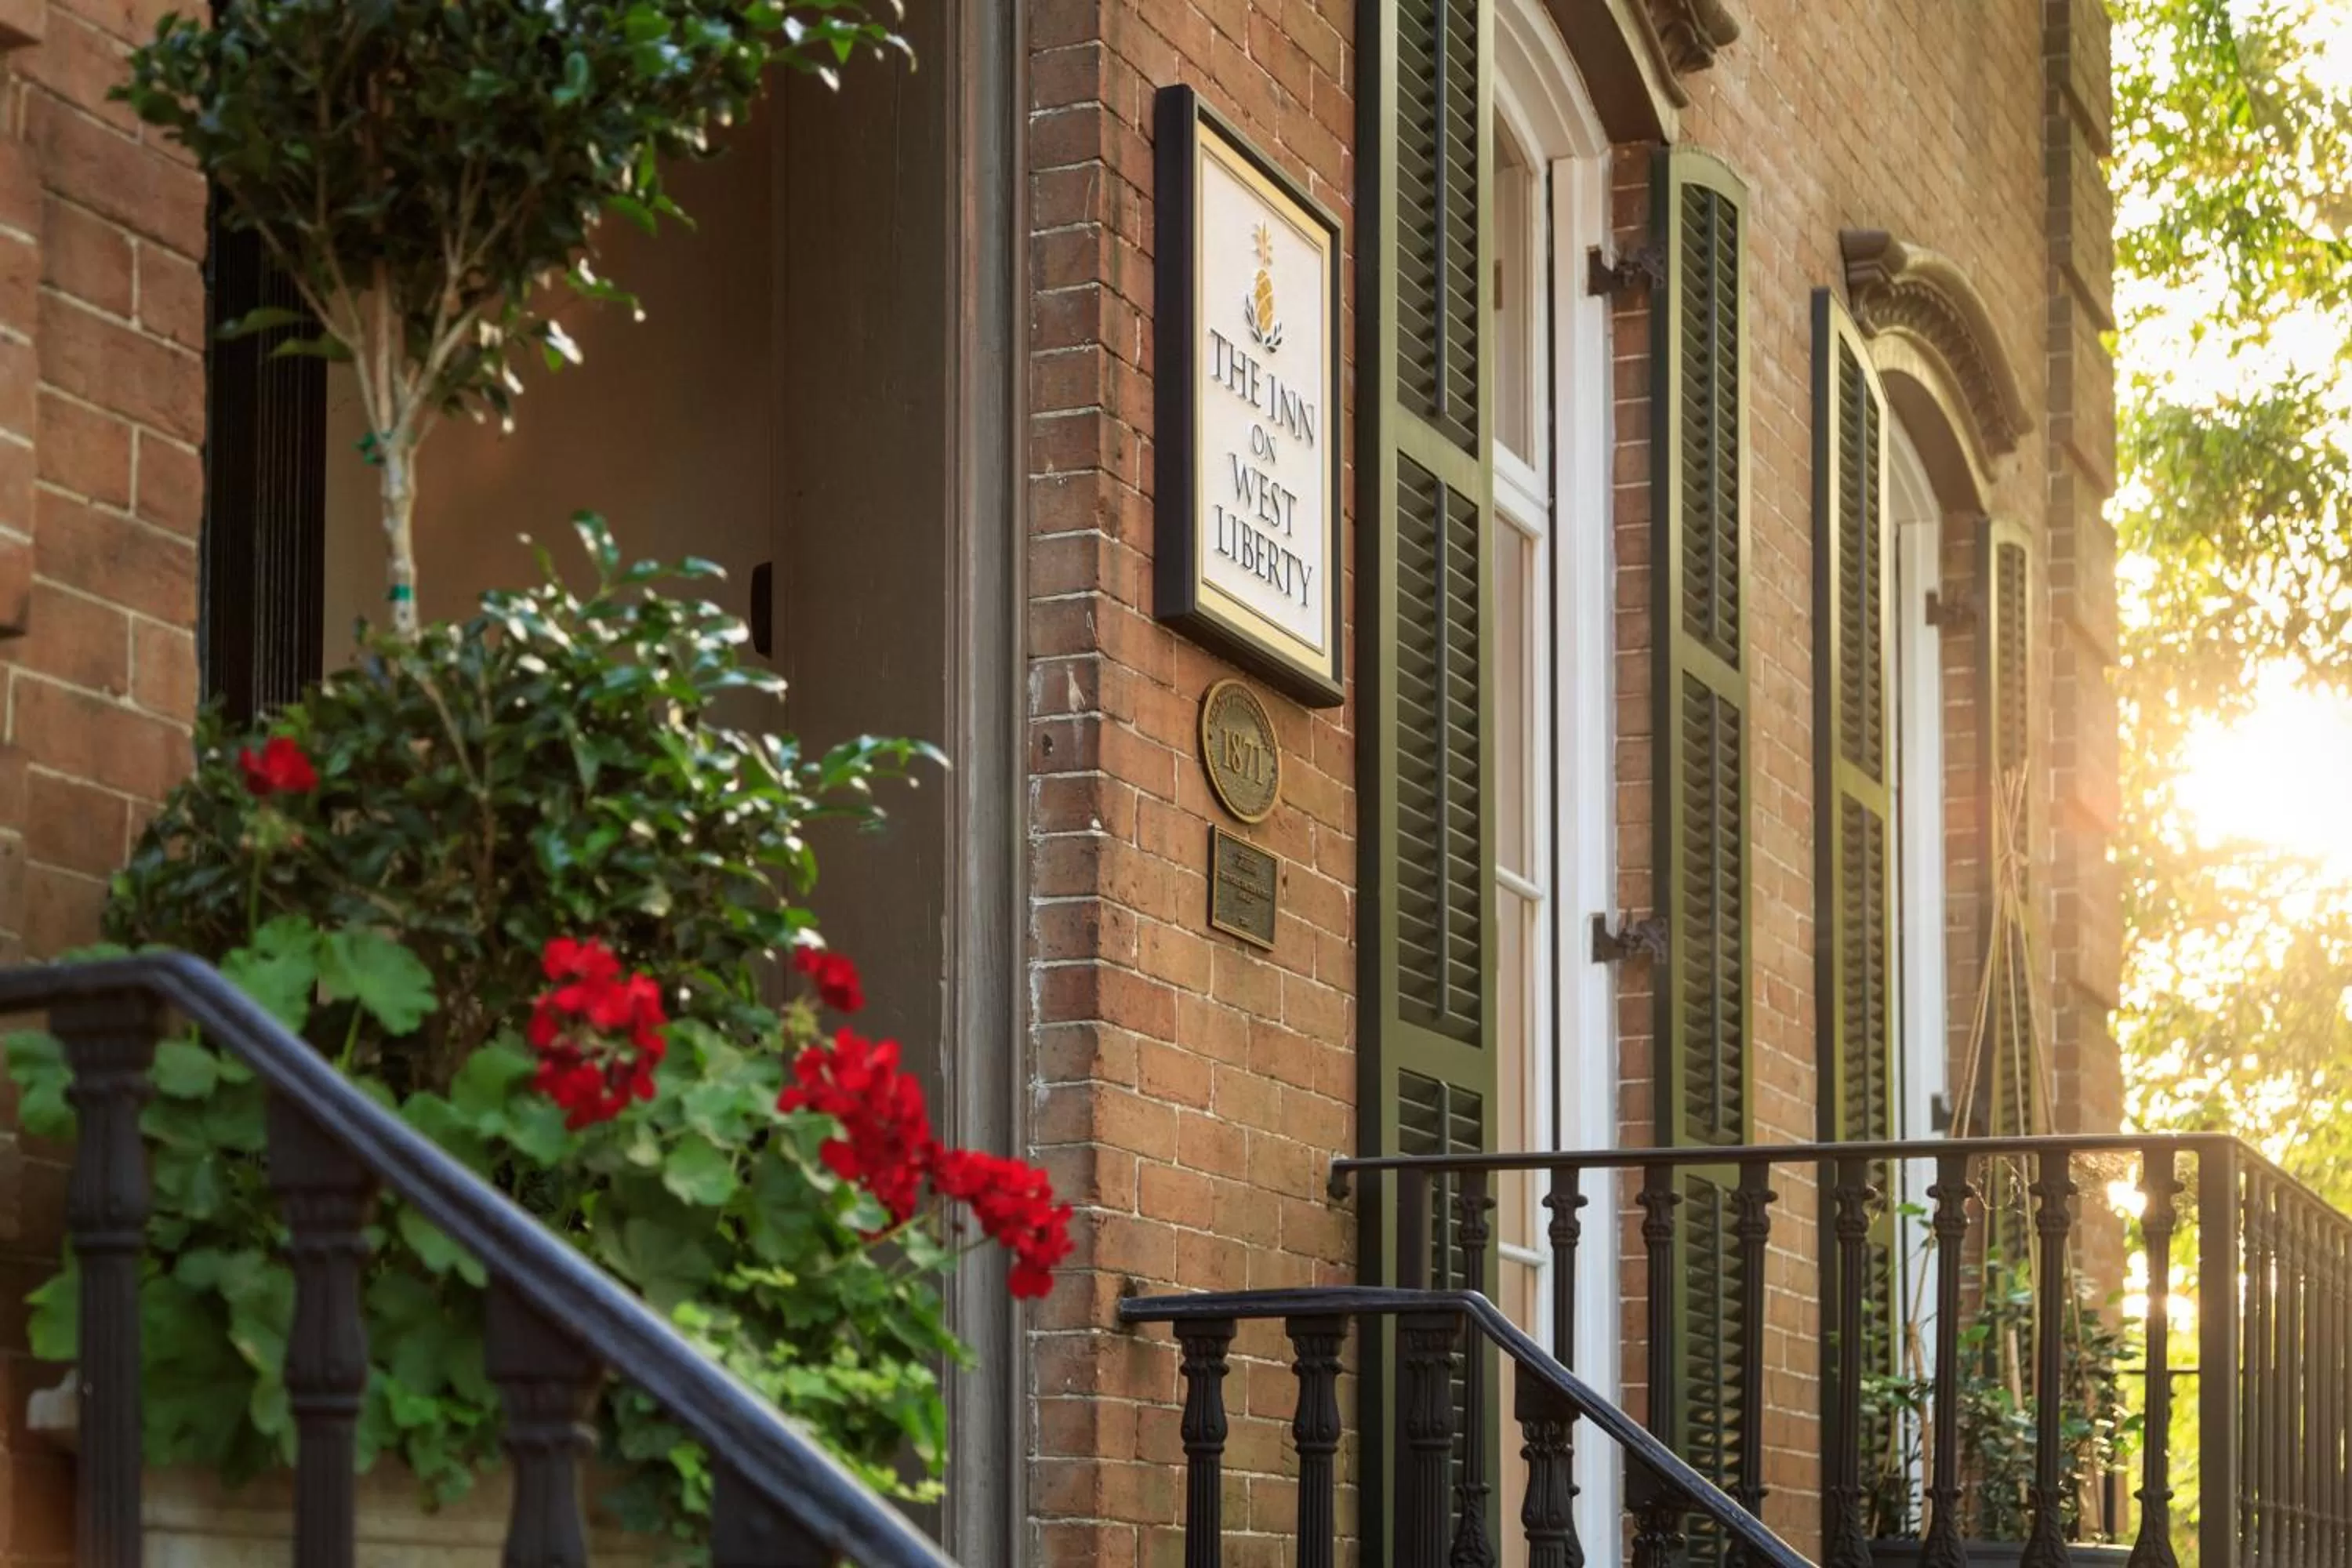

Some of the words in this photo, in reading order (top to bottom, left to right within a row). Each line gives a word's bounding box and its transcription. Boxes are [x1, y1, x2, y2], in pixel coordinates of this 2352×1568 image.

[1209, 328, 1261, 408] THE
[1267, 372, 1316, 447] INN
[1251, 423, 1276, 464] ON
[1228, 452, 1297, 538] WEST
[1213, 504, 1313, 608] LIBERTY
[1221, 727, 1265, 786] 1871
